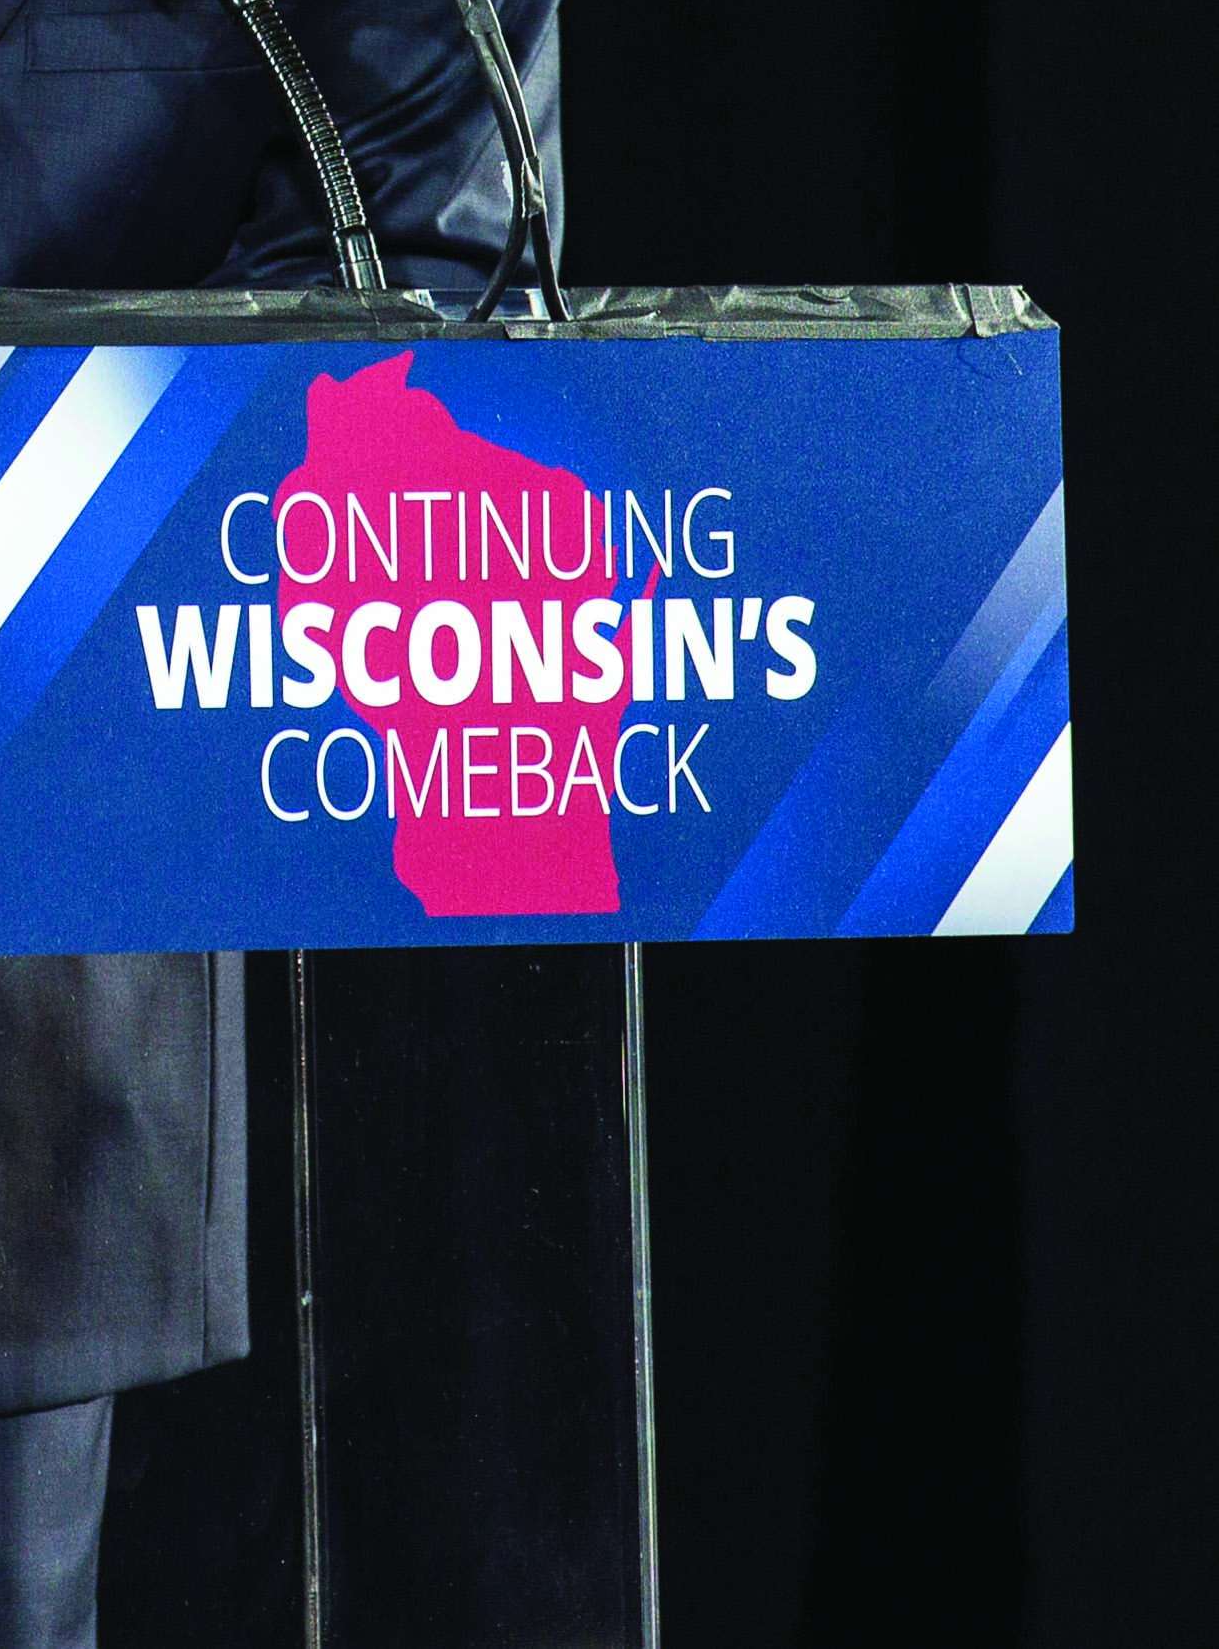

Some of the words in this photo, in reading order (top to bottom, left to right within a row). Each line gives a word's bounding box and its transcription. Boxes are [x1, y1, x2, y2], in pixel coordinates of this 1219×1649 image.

[220, 487, 735, 585] CONTINUING
[135, 595, 817, 710] WISCONSIN'S
[261, 723, 712, 821] COMEBACK
